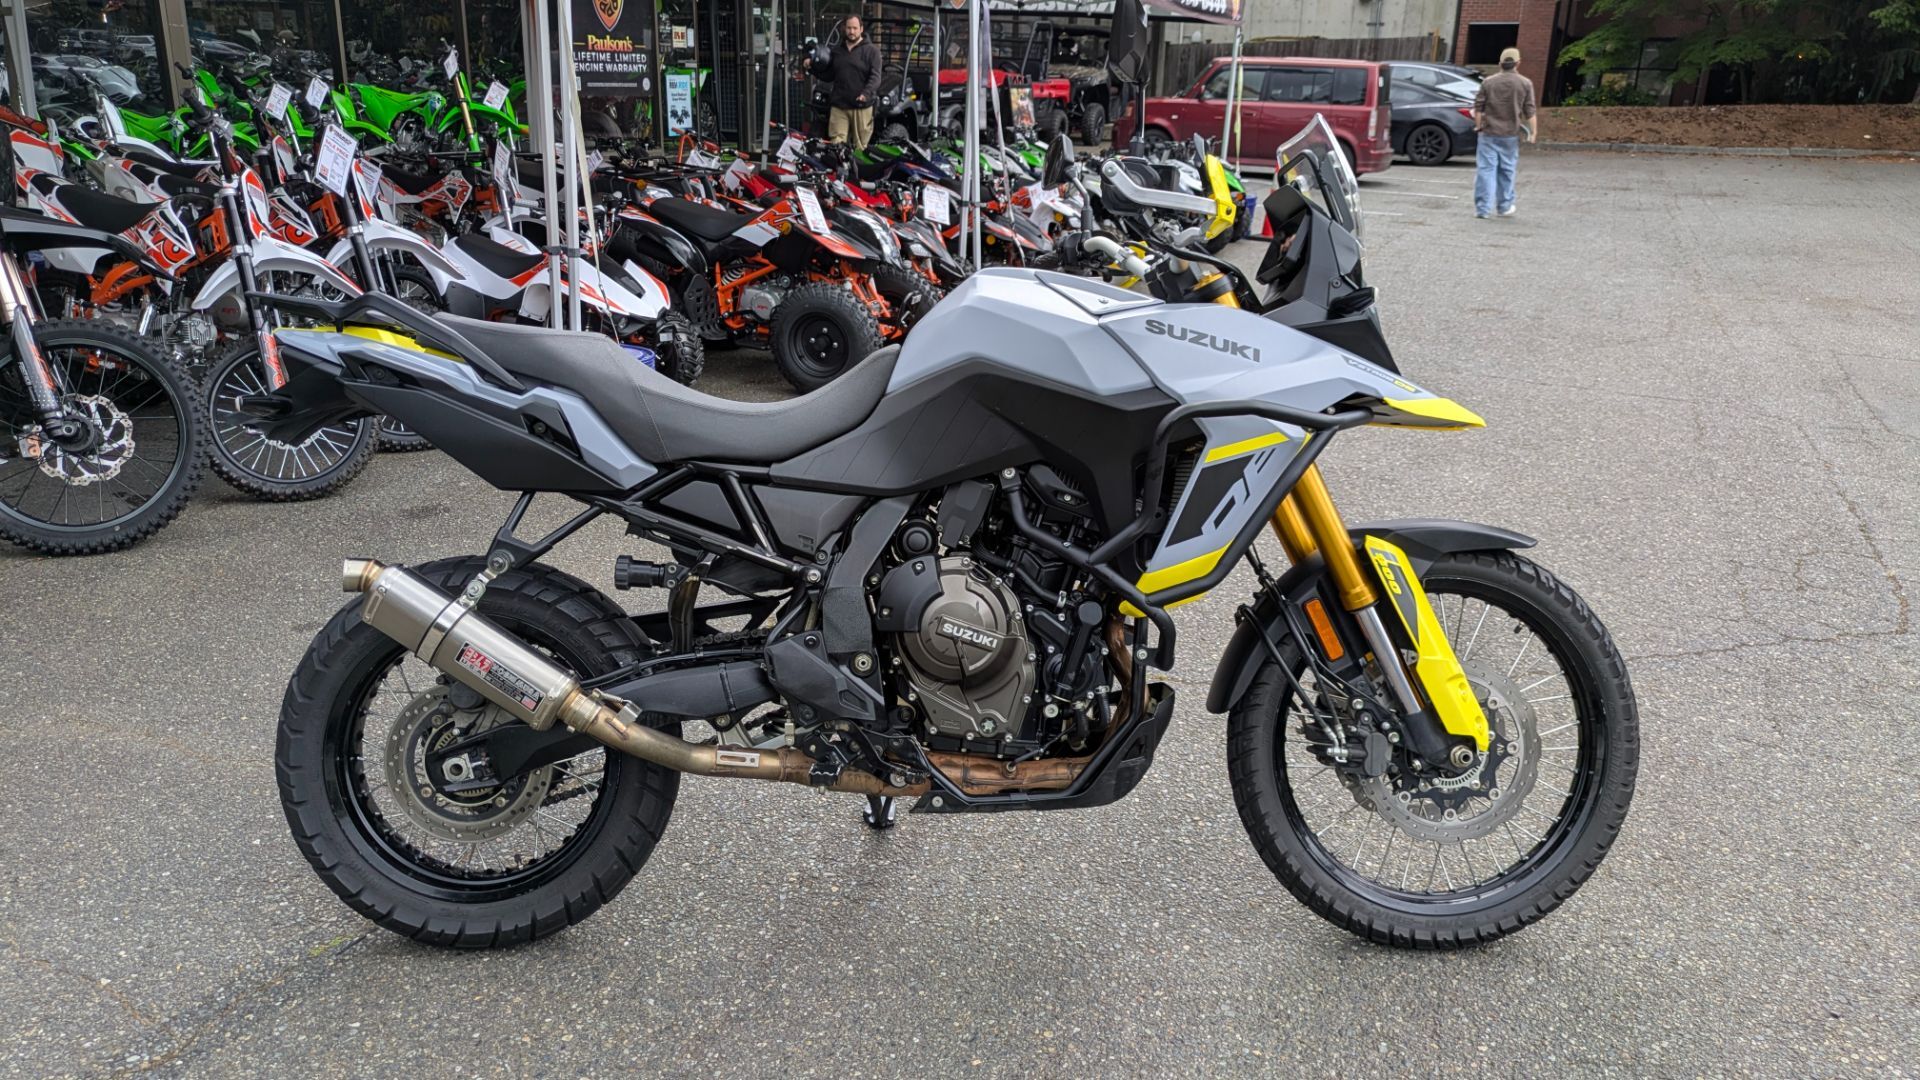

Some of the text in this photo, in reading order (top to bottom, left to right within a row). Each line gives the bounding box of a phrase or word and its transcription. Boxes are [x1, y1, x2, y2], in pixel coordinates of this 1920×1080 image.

[587, 34, 633, 52] Paulson's
[573, 52, 647, 63] LIFETIME LIMITED
[575, 62, 647, 73] ENGINE WARRANTY
[1145, 319, 1261, 363] SUZUKI
[1374, 552, 1402, 595] 800
[942, 622, 998, 649] SUZUKI
